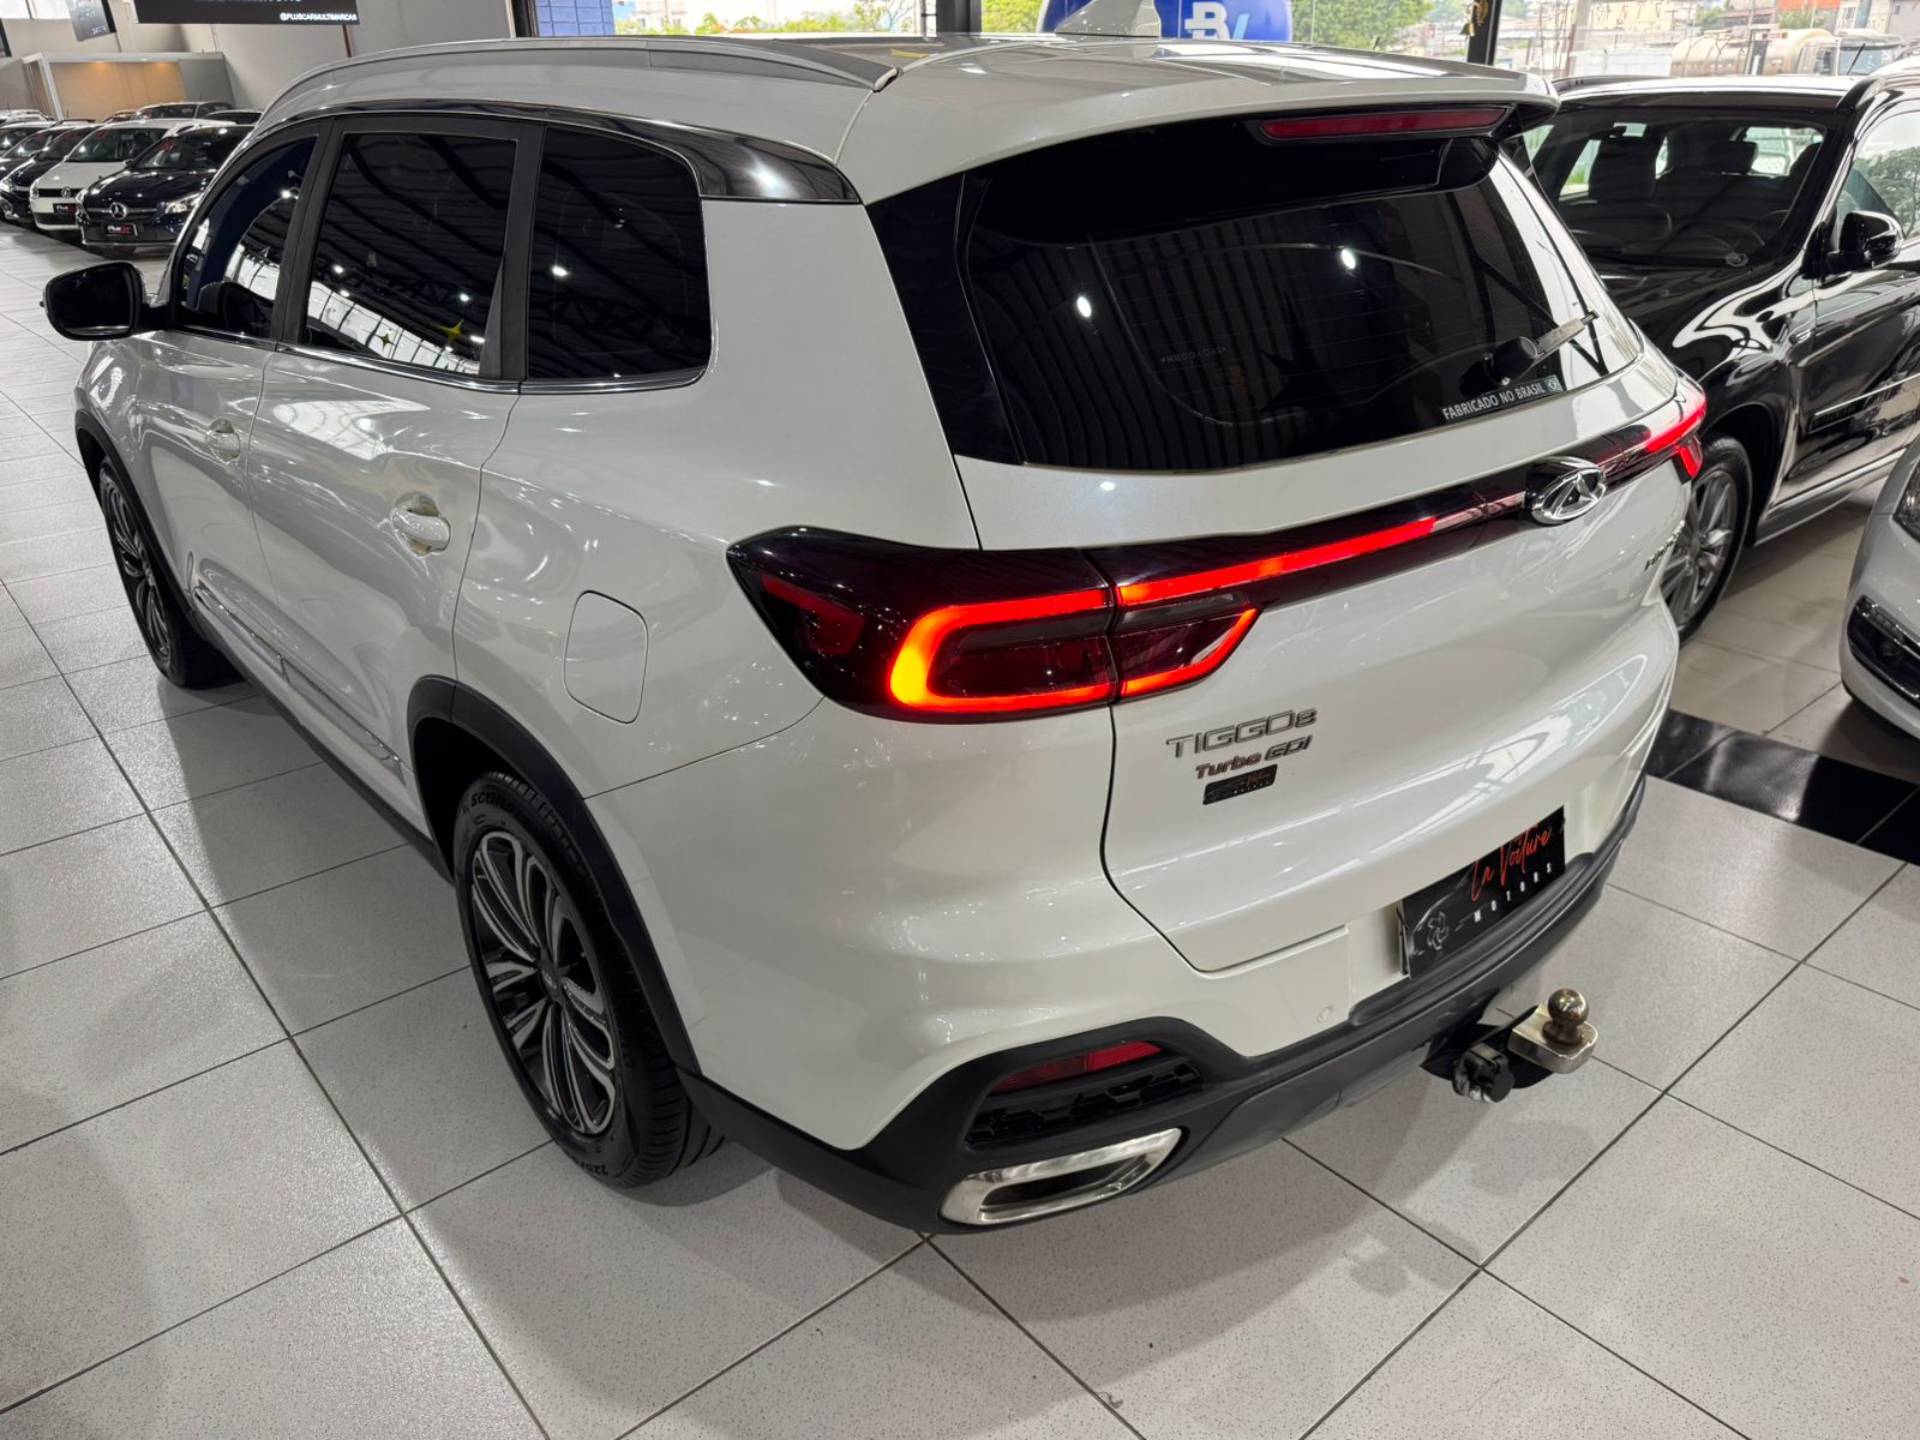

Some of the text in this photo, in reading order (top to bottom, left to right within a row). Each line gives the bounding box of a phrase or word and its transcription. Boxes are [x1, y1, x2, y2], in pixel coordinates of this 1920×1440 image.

[1442, 382, 1545, 420] FABRICADO NO BRASIL
[1195, 734, 1314, 779] Turbo GDI
[1473, 861, 1552, 923] MOTORS
